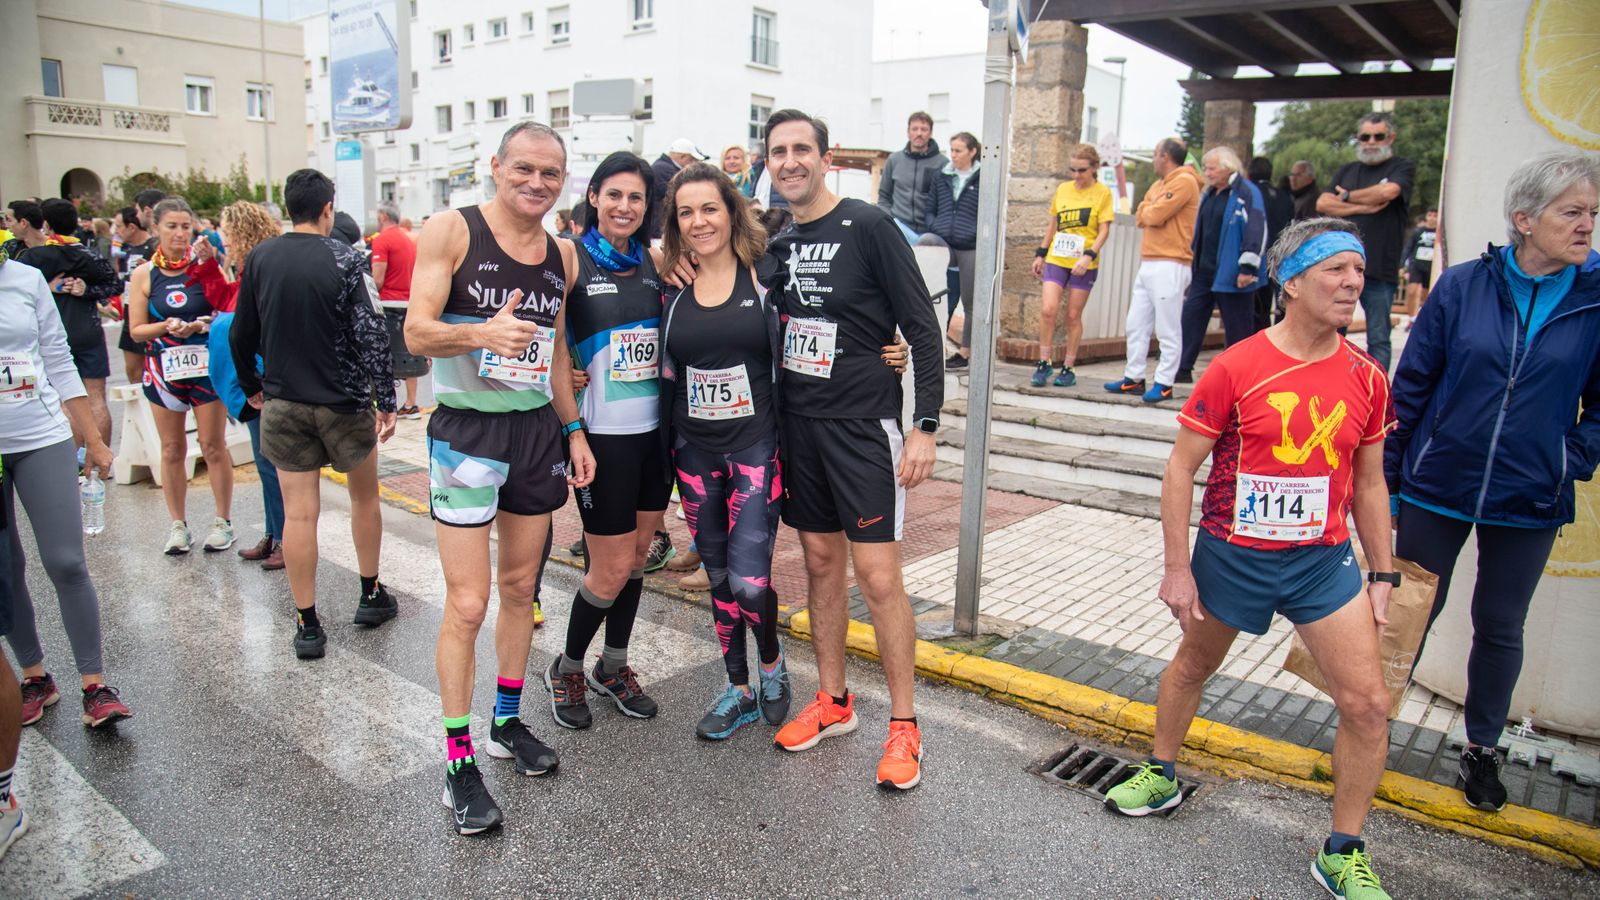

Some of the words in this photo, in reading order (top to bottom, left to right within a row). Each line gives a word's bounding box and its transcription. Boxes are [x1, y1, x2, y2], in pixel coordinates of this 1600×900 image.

[800, 243, 841, 261] XIV
[478, 260, 500, 272] vive
[620, 333, 640, 343] XIV
[793, 333, 818, 357] 174
[626, 342, 654, 363] 169
[174, 354, 198, 368] 140
[693, 372, 708, 383] XIV
[720, 375, 744, 383] ESTRECHO
[698, 383, 732, 402] 175
[1251, 480, 1280, 494] XIV
[1258, 494, 1304, 519] 114
